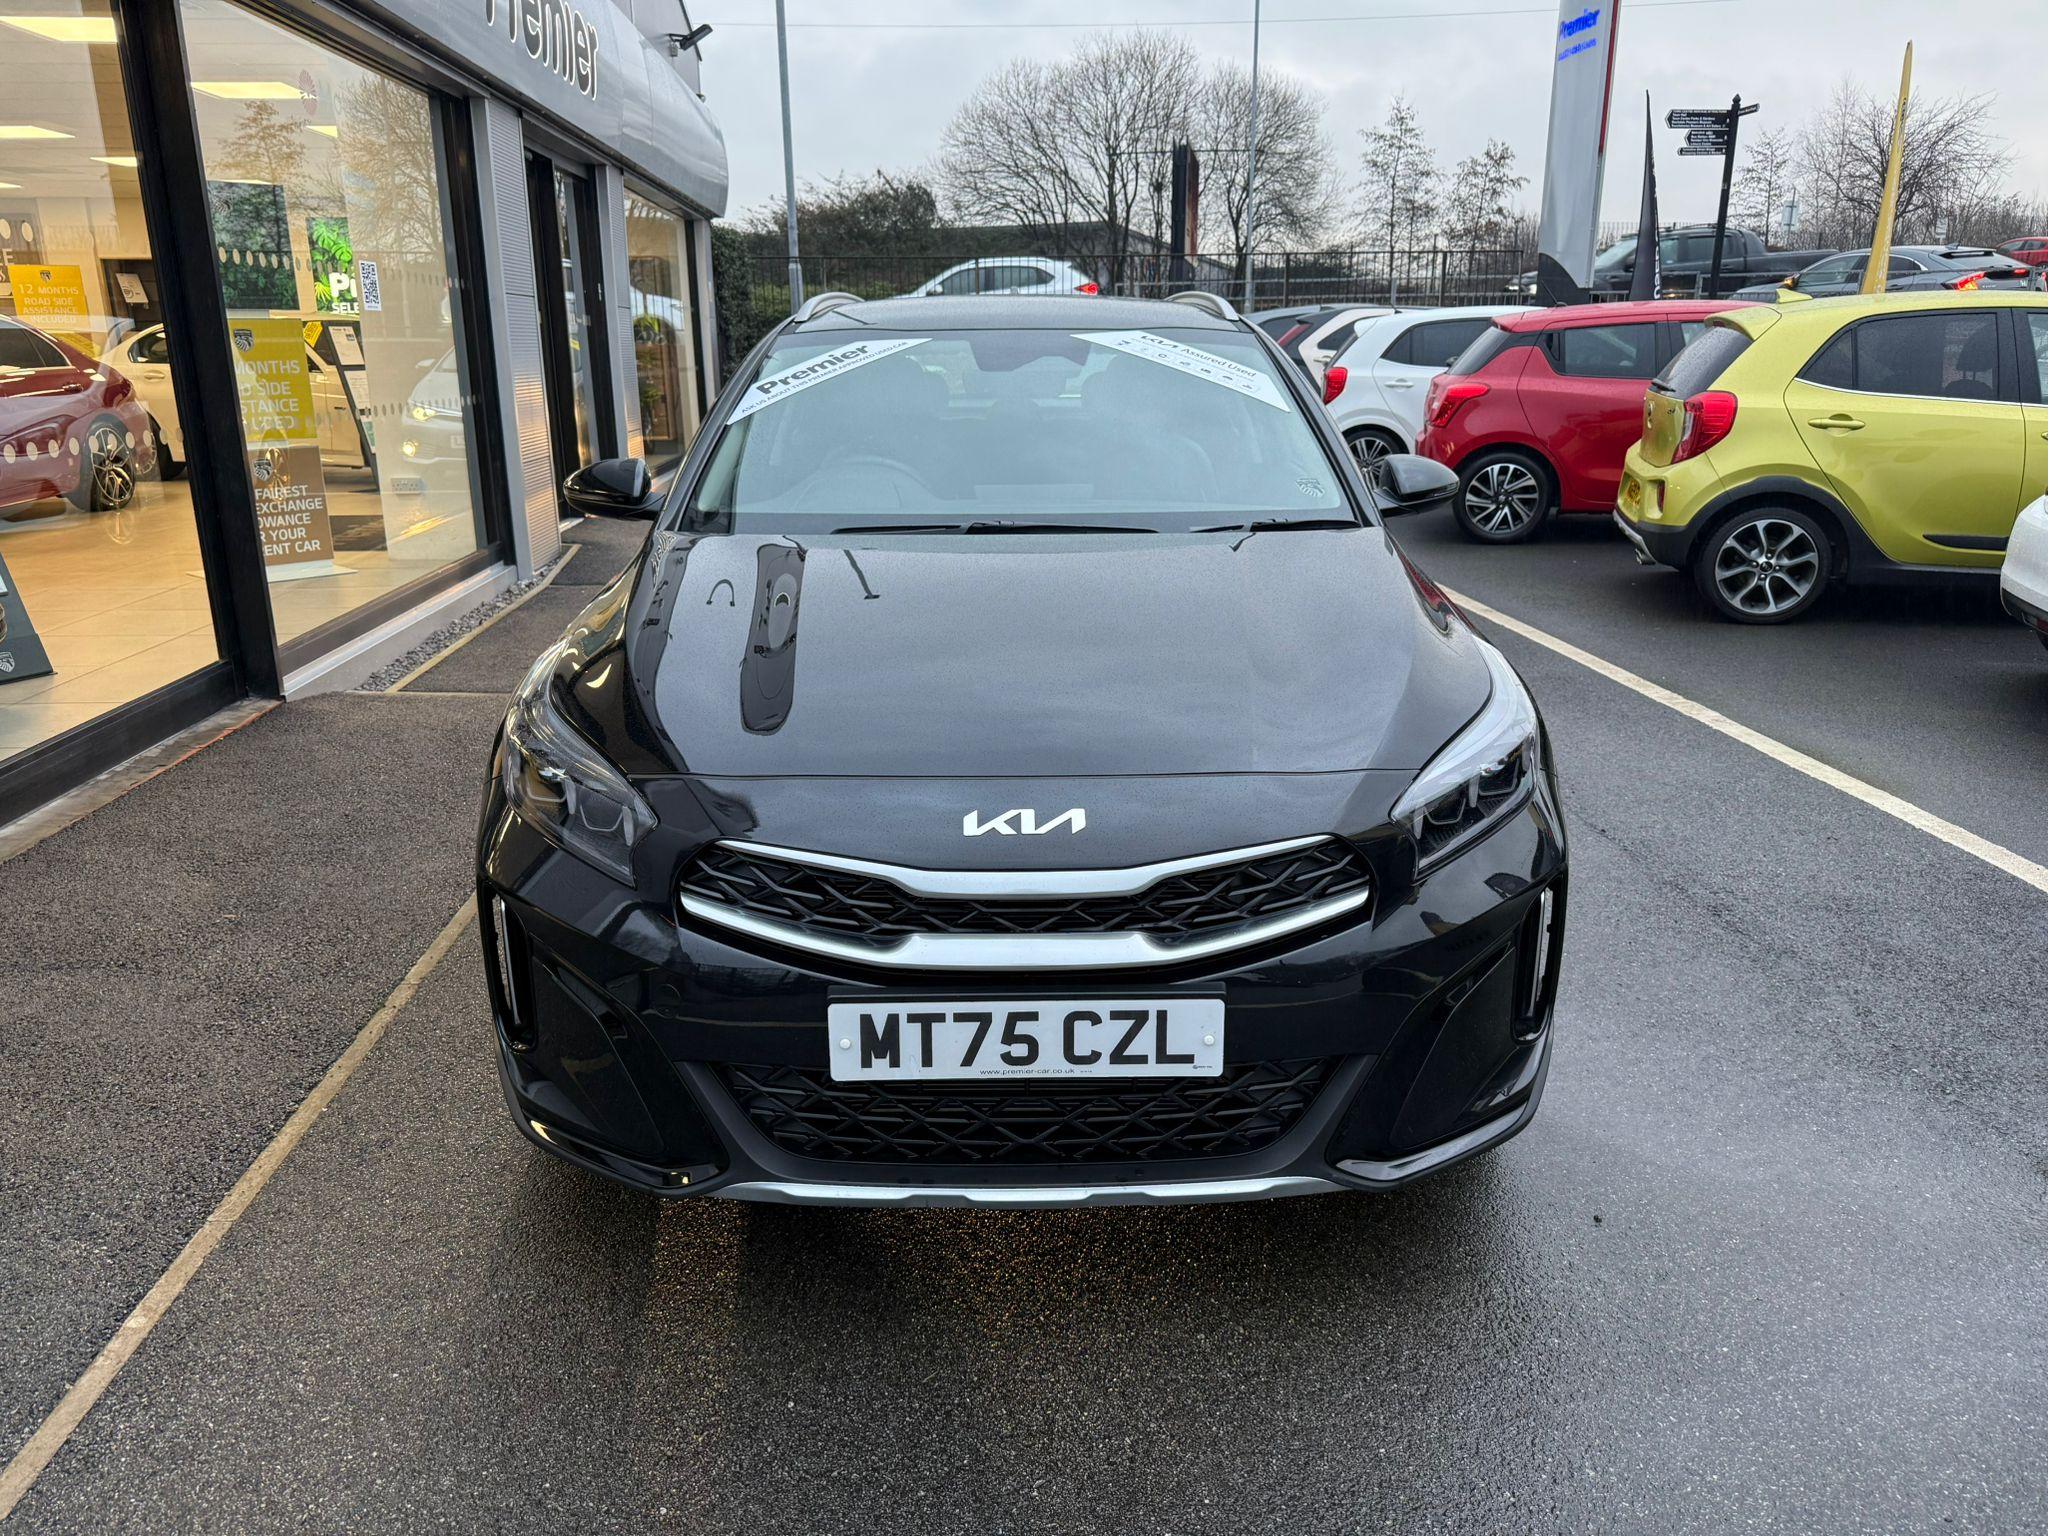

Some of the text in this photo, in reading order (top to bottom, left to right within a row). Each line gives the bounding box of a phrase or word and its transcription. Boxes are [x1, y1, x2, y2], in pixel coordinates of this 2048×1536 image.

[486, 0, 599, 101] emier
[39, 286, 79, 295] MONTHS
[24, 297, 51, 306] ROAD
[756, 346, 868, 394] Premier
[1181, 348, 1228, 366] Assured
[1228, 363, 1257, 377] Used
[257, 380, 292, 396] SIDE
[255, 485, 308, 500] FAIREST
[269, 527, 307, 542] YOUR
[295, 539, 321, 553] CAR
[963, 808, 1086, 837] KIA
[860, 1010, 1195, 1068] MT75 CZL
[980, 1068, 1075, 1076] www.premier-car.co.uk
